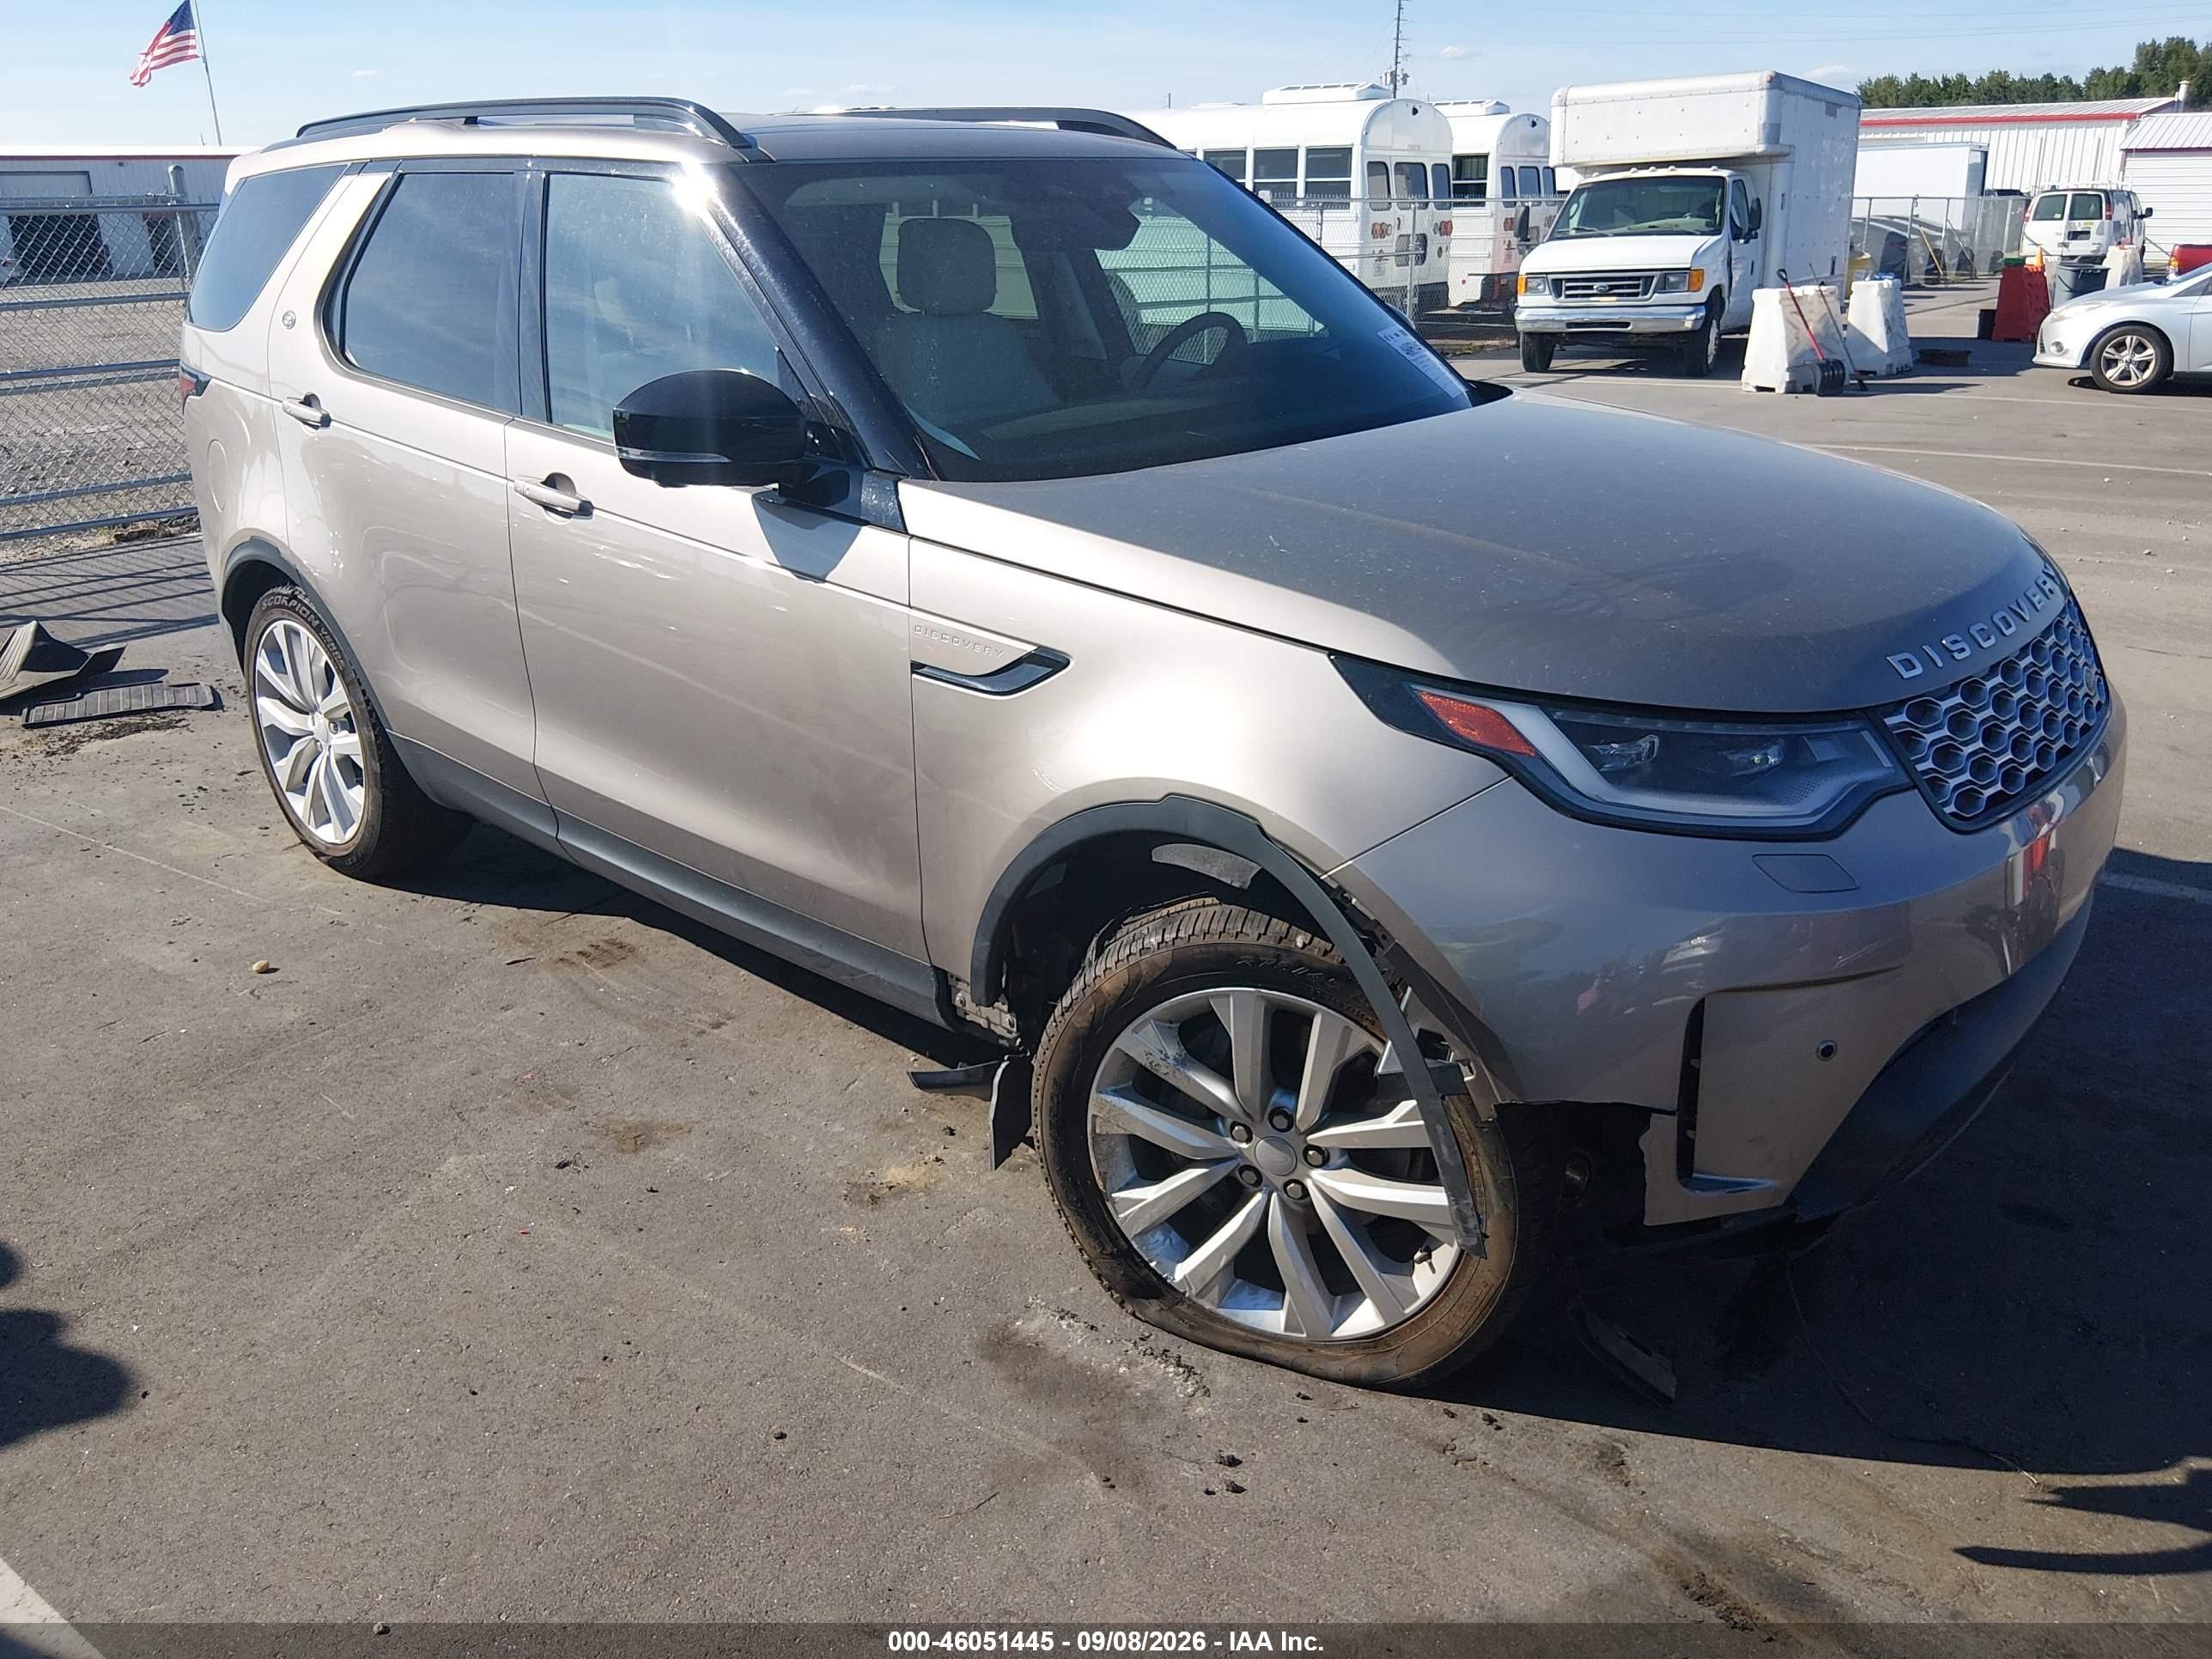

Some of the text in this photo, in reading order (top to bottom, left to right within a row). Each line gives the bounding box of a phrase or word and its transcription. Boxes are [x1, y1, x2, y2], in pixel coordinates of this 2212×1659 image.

[261, 595, 319, 628] SCORPION
[1886, 562, 2059, 678] DISCOVERY
[913, 624, 1004, 659] DISCOVERY
